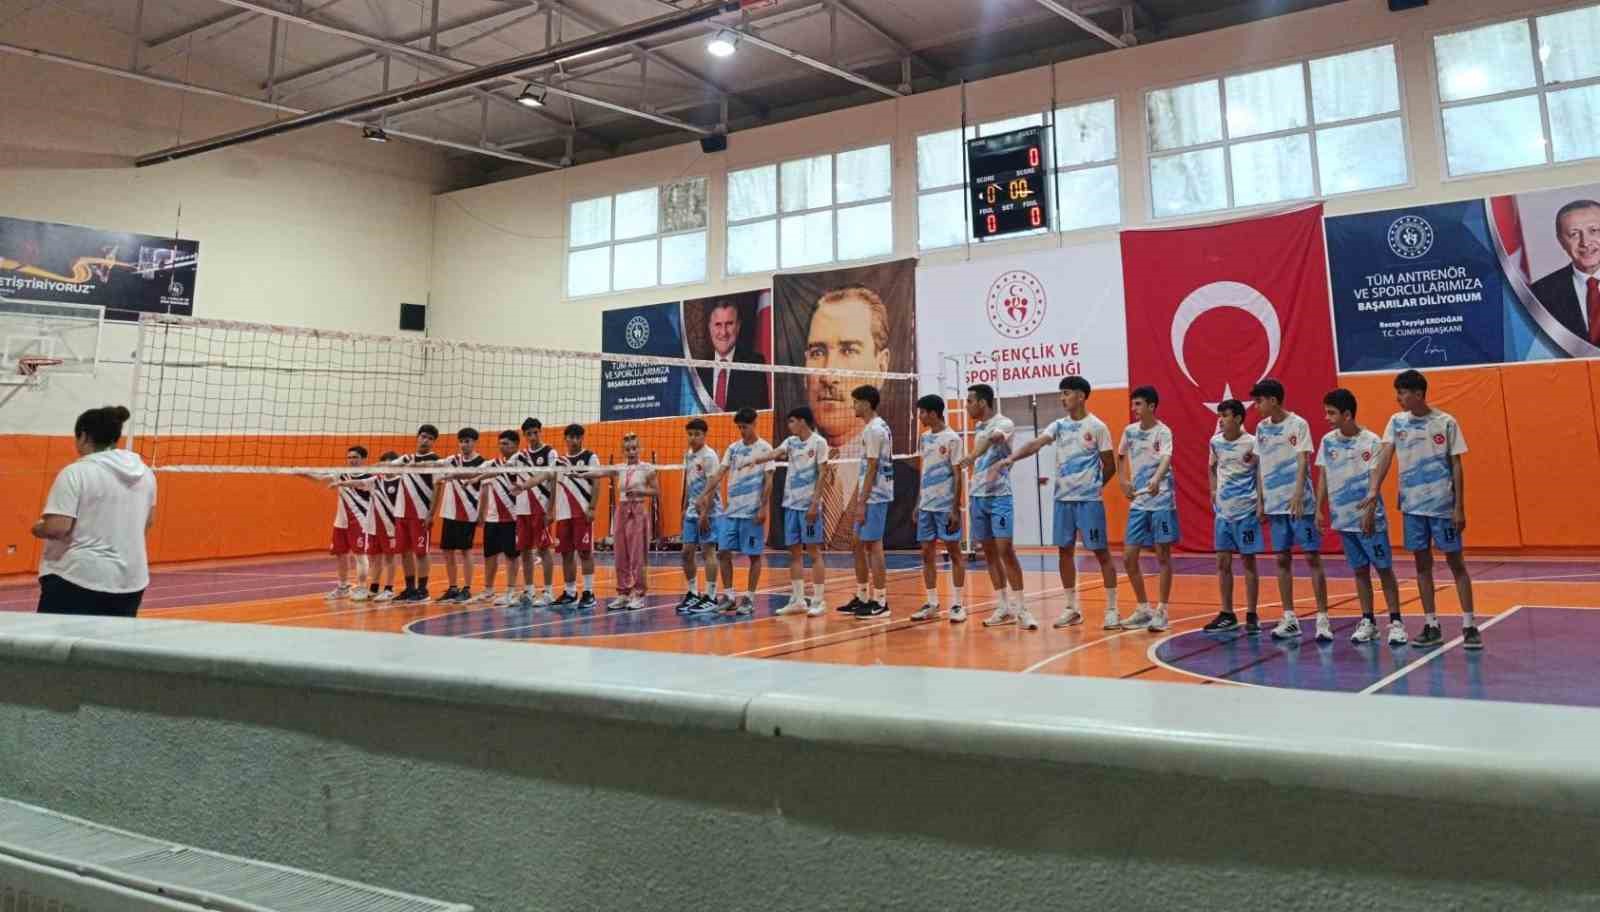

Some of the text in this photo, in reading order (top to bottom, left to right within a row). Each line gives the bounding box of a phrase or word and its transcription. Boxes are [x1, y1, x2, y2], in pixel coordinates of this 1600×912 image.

[1029, 147, 1039, 167] 0
[976, 175, 995, 184] SCORE
[1016, 167, 1036, 177] SCORE
[987, 184, 996, 204] 0
[979, 207, 994, 215] FOUL
[1001, 203, 1014, 211] SET
[1022, 200, 1037, 208] FOUL
[987, 214, 997, 233] 0
[1031, 206, 1041, 227] 0
[1366, 266, 1467, 287] TÜM ANTRENÖR
[1353, 278, 1483, 300] VE SPORCULARIMIZA
[1357, 291, 1482, 312] BAŞARILAR DİLİYORUM
[990, 343, 1055, 364] GENÇLİK
[1059, 342, 1080, 357] VE
[1002, 360, 1081, 381] BAKANLIĞI
[416, 536, 425, 548] 2
[581, 533, 590, 545] 4
